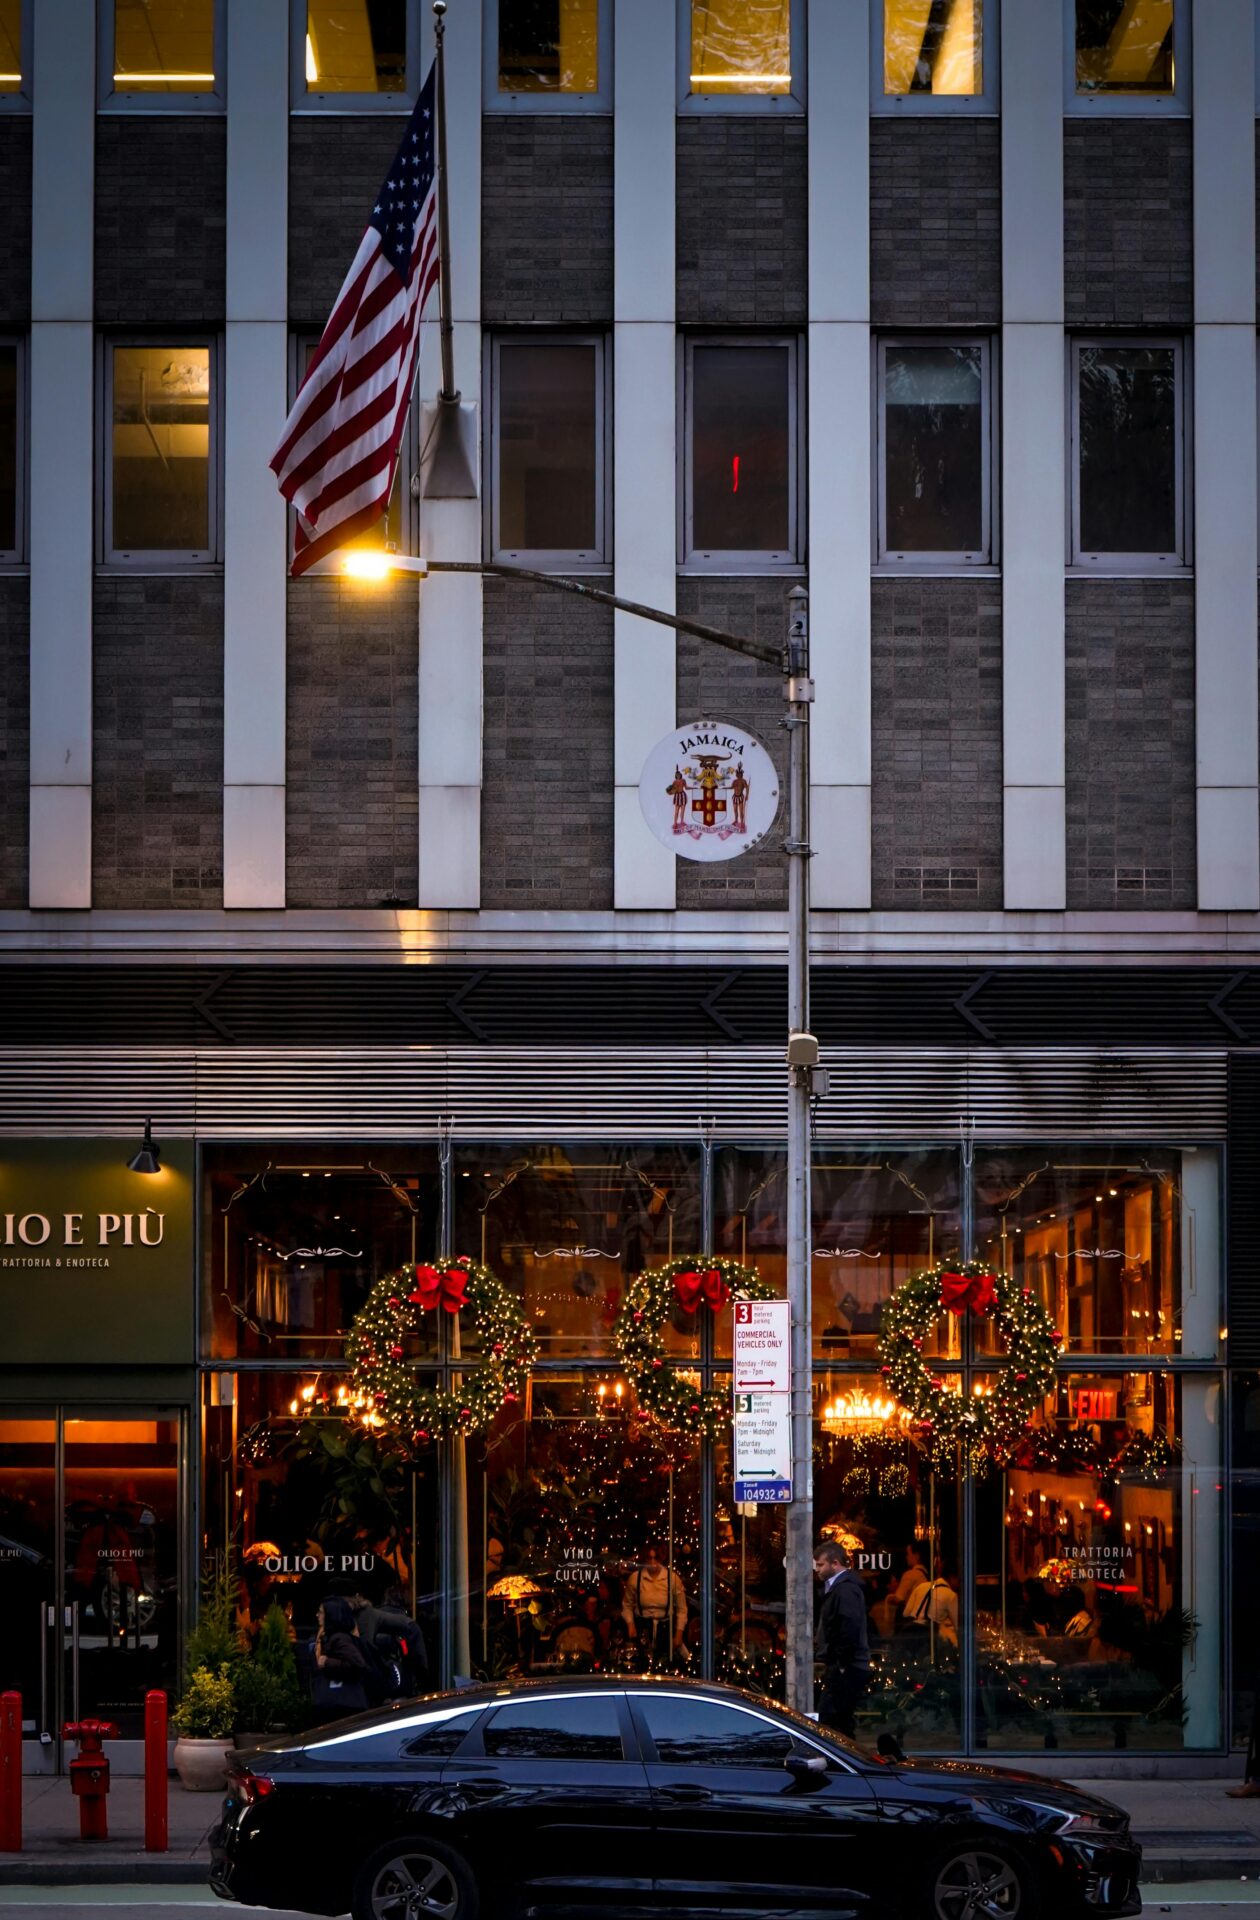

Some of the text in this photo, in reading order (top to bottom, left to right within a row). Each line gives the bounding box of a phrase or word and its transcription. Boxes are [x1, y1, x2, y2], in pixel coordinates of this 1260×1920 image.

[680, 735, 744, 755] JAMAICA
[0, 1207, 165, 1246] IO E PIÙ
[0, 1258, 110, 1268] RATTORIA & ENOTECA
[739, 1305, 749, 1323] 3
[737, 1330, 776, 1339] COMMERCIAL
[737, 1340, 783, 1349] VEHICLES ONLY
[737, 1360, 757, 1368] Monday
[761, 1360, 777, 1368] Friday
[739, 1395, 749, 1412] 5
[1078, 1391, 1113, 1419] EXIT
[761, 1420, 778, 1428] Friday
[753, 1428, 775, 1436] Midnight
[737, 1440, 761, 1448] Saturday
[753, 1448, 776, 1456] Midnight
[743, 1489, 775, 1500] 104932
[97, 1549, 120, 1557] OLIO
[122, 1549, 127, 1557] E
[563, 1548, 593, 1560] VINO
[1064, 1546, 1133, 1558] TRATTORIA
[265, 1552, 375, 1573] OLIO E PIÙ
[858, 1550, 892, 1570] PIÙ
[555, 1569, 600, 1581] CUCINA
[1071, 1568, 1126, 1579] ENOTECA
